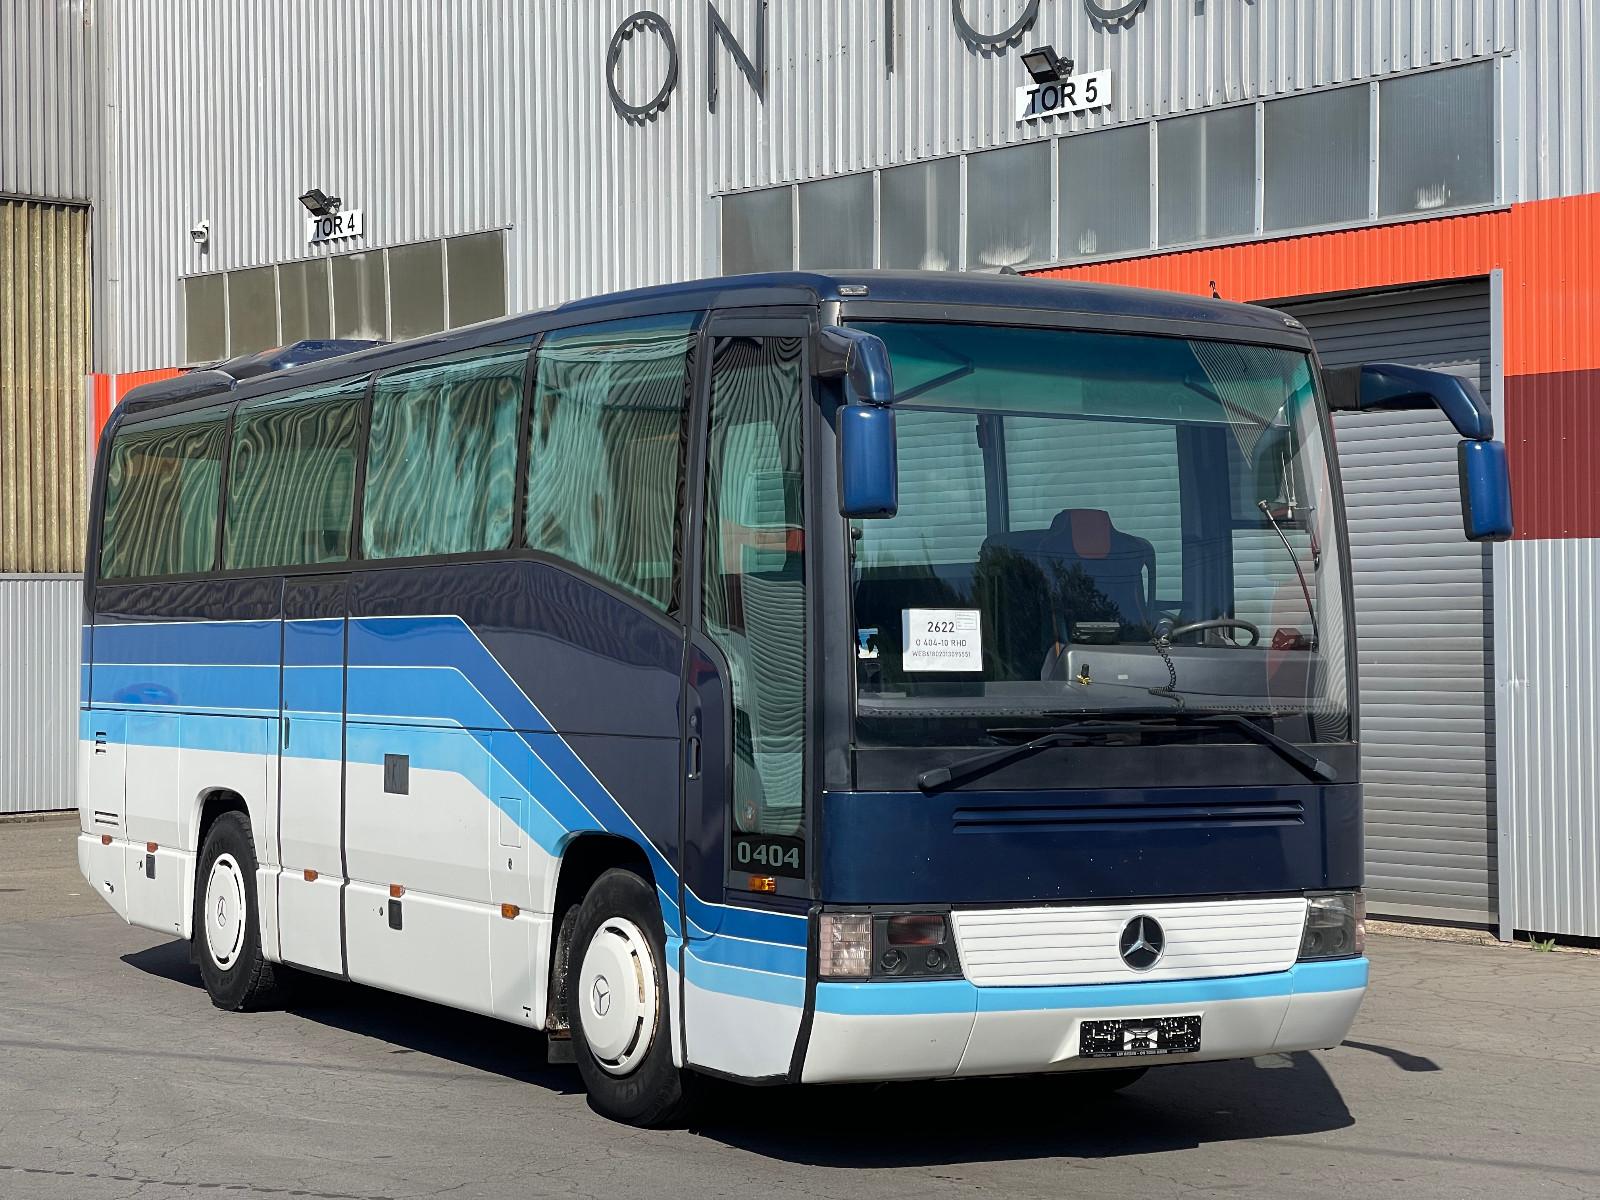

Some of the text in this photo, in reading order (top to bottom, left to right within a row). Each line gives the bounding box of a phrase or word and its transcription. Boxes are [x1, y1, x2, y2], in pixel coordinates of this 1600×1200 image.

[1026, 78, 1098, 113] TOR 5
[313, 213, 356, 238] TOR 4
[927, 621, 955, 633] 2622
[923, 639, 949, 647] 404-10
[950, 639, 967, 647] RHD
